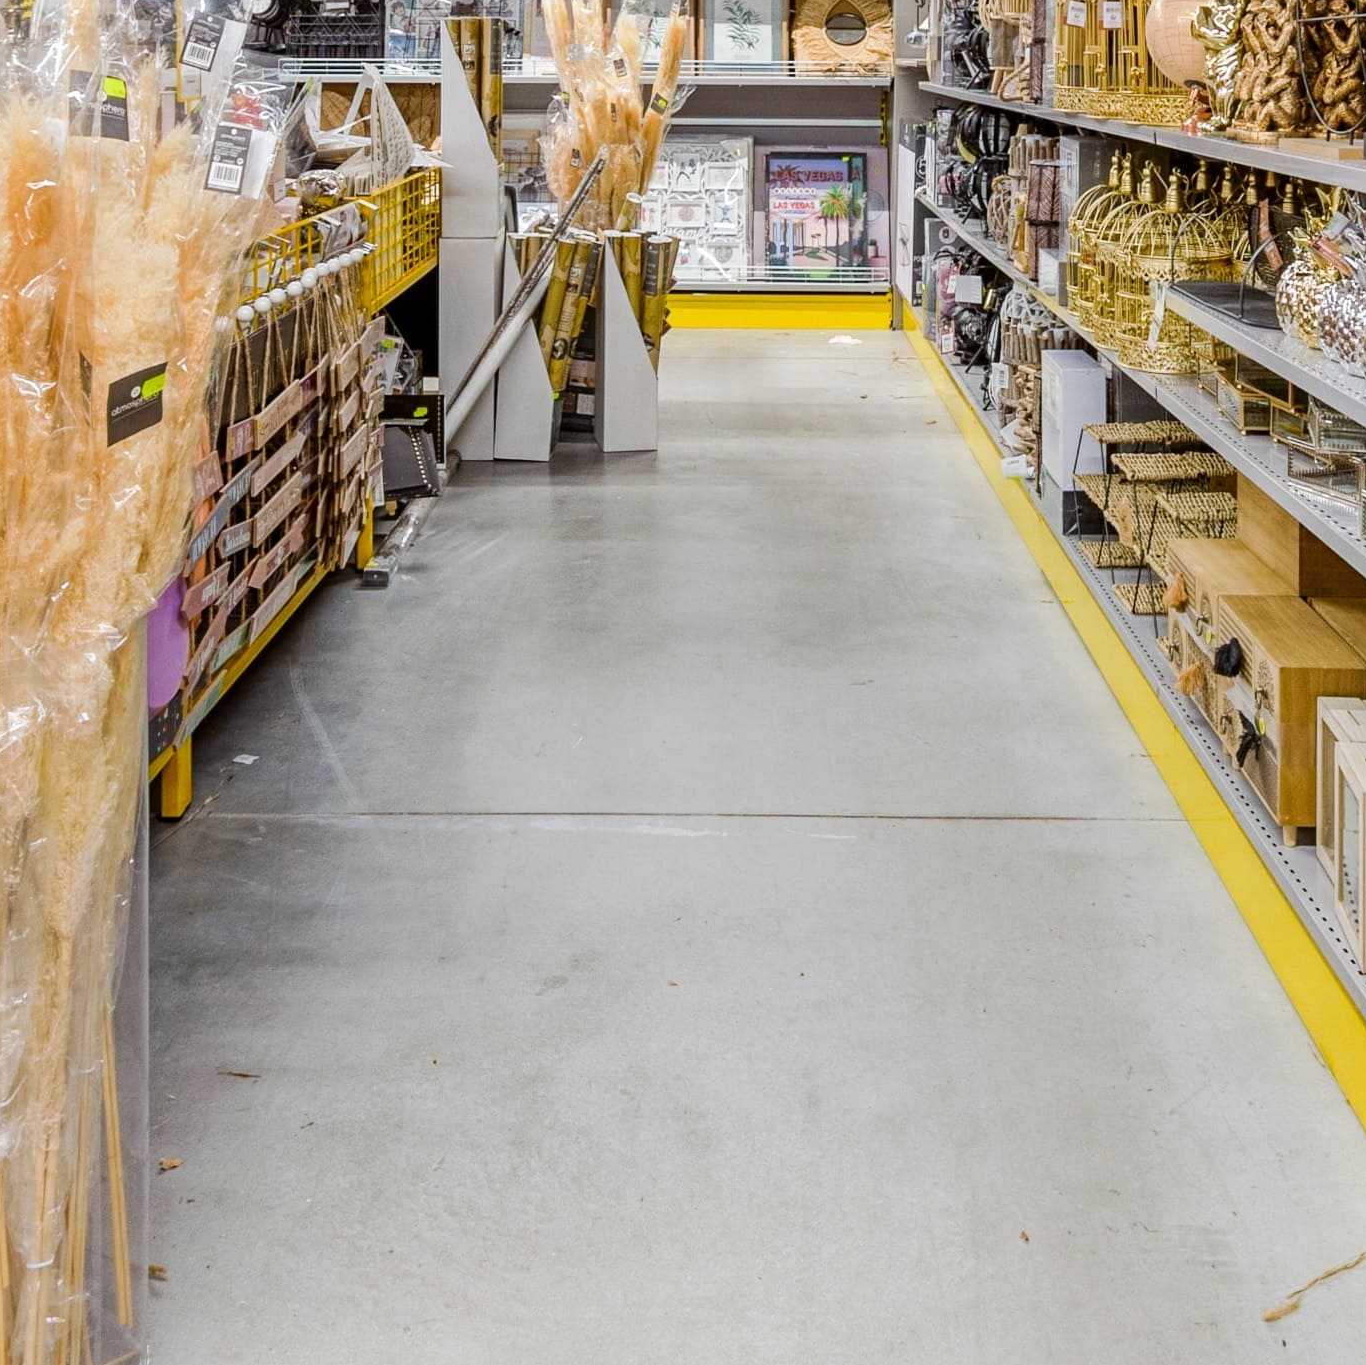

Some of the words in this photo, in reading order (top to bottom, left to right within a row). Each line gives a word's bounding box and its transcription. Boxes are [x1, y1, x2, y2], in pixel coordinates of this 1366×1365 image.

[804, 170, 843, 182] VEGAS
[773, 201, 788, 209] LAS
[790, 201, 815, 209] VEGAS
